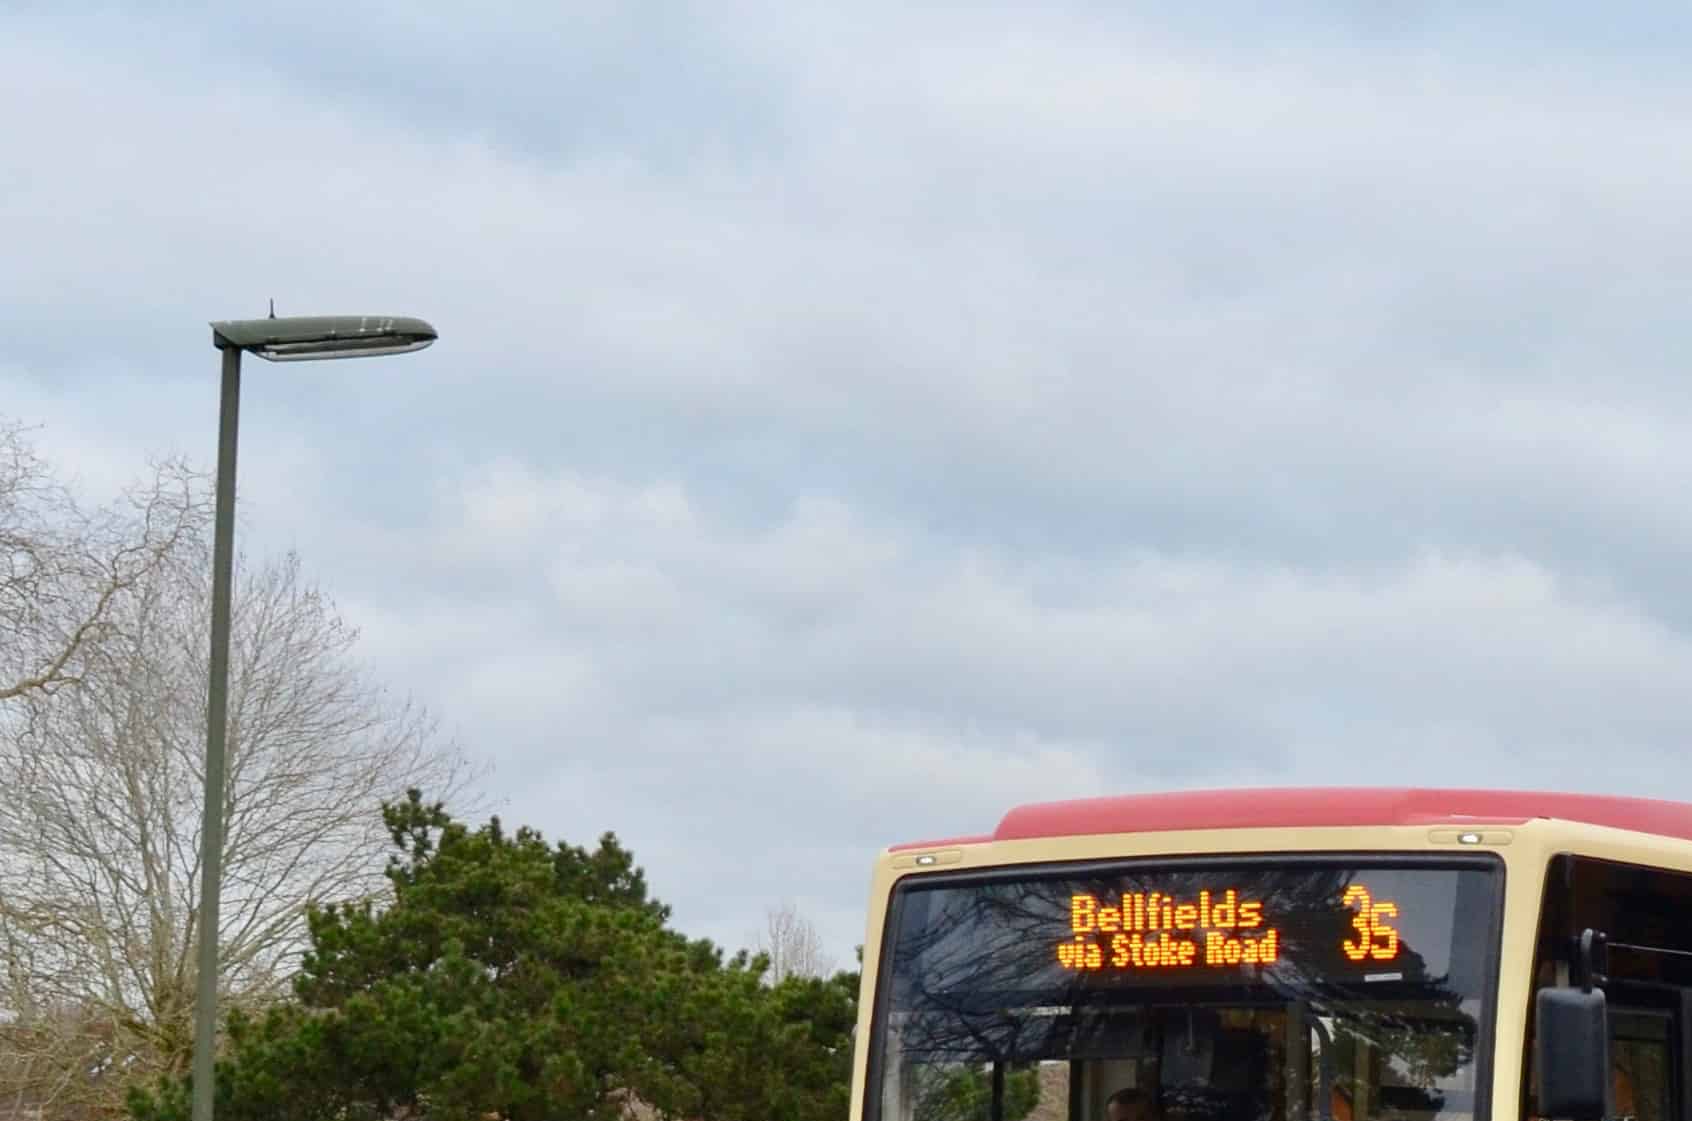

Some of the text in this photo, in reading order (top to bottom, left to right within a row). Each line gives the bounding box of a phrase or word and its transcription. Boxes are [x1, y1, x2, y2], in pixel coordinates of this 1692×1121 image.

[1071, 889, 1263, 933] Bellfields
[1057, 929, 1278, 968] via Stoke Road
